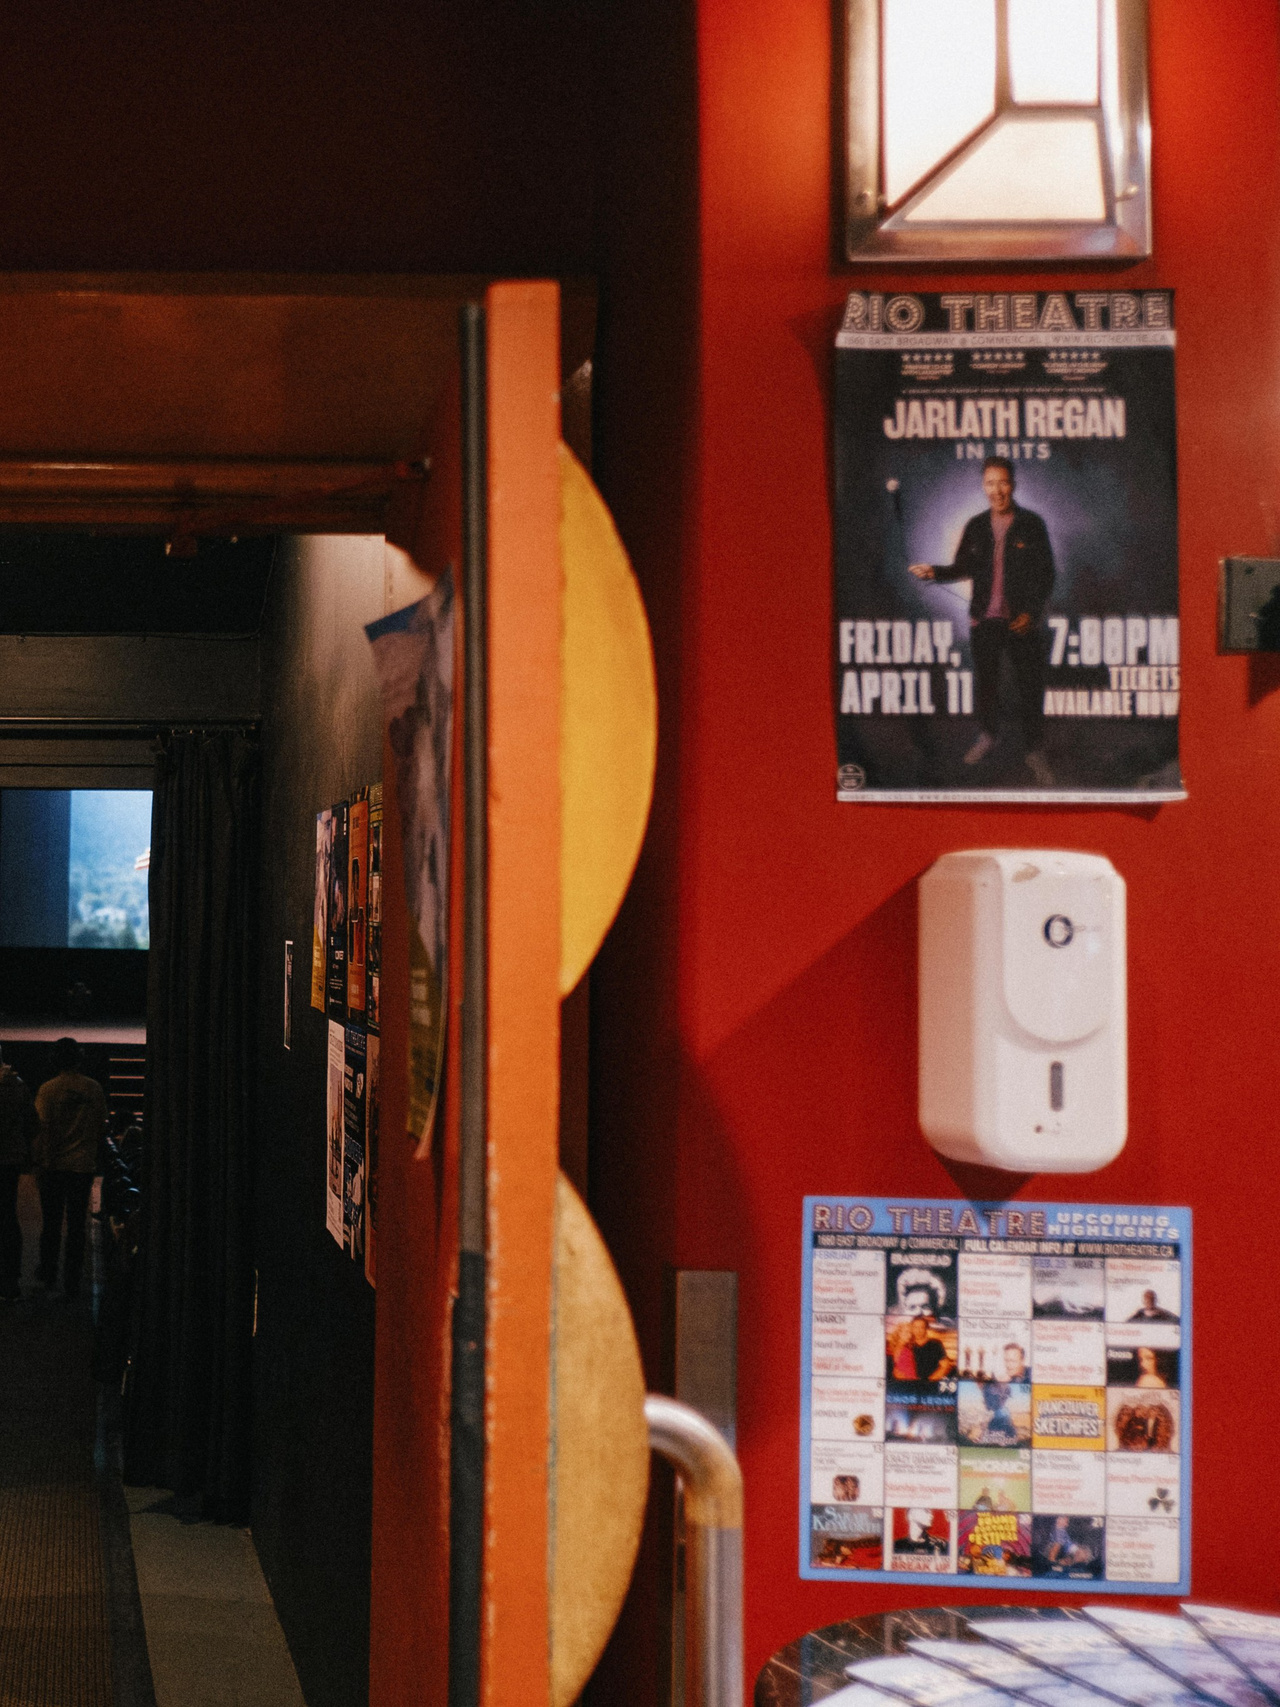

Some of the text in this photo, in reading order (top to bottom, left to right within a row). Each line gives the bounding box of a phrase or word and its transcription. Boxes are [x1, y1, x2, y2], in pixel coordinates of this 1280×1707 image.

[842, 292, 1170, 334] RIO THEATRE
[883, 398, 1126, 440] JARLATH REGAN
[956, 442, 1052, 460] IN BITS
[839, 620, 962, 668] FRIDAY,
[1108, 665, 1181, 691] TICKETS
[840, 670, 974, 714] APRIL 11
[1043, 690, 1133, 716] AVAILABLE
[812, 1204, 1046, 1238] RIO THEATRE
[1056, 1212, 1169, 1227] UPCOMING
[1048, 1224, 1180, 1240] HIGHLIGHTS
[836, 1235, 856, 1247] EAST
[857, 1236, 900, 1248] BROADWAY
[908, 1237, 959, 1250] COMMERCIAL
[964, 1239, 1175, 1257] FULL CALENDAR INFO AT WWW.RIOTHEATRE.CA
[813, 1251, 858, 1260] FEBRUARY
[889, 1253, 952, 1267] ERASERHEAD
[814, 1314, 846, 1324] MARCH
[938, 1381, 958, 1393] 7-9
[1036, 1400, 1100, 1419] VANCOUVER
[1033, 1417, 1106, 1438] SKETCHFEST
[891, 1561, 951, 1572] BREAK UP
